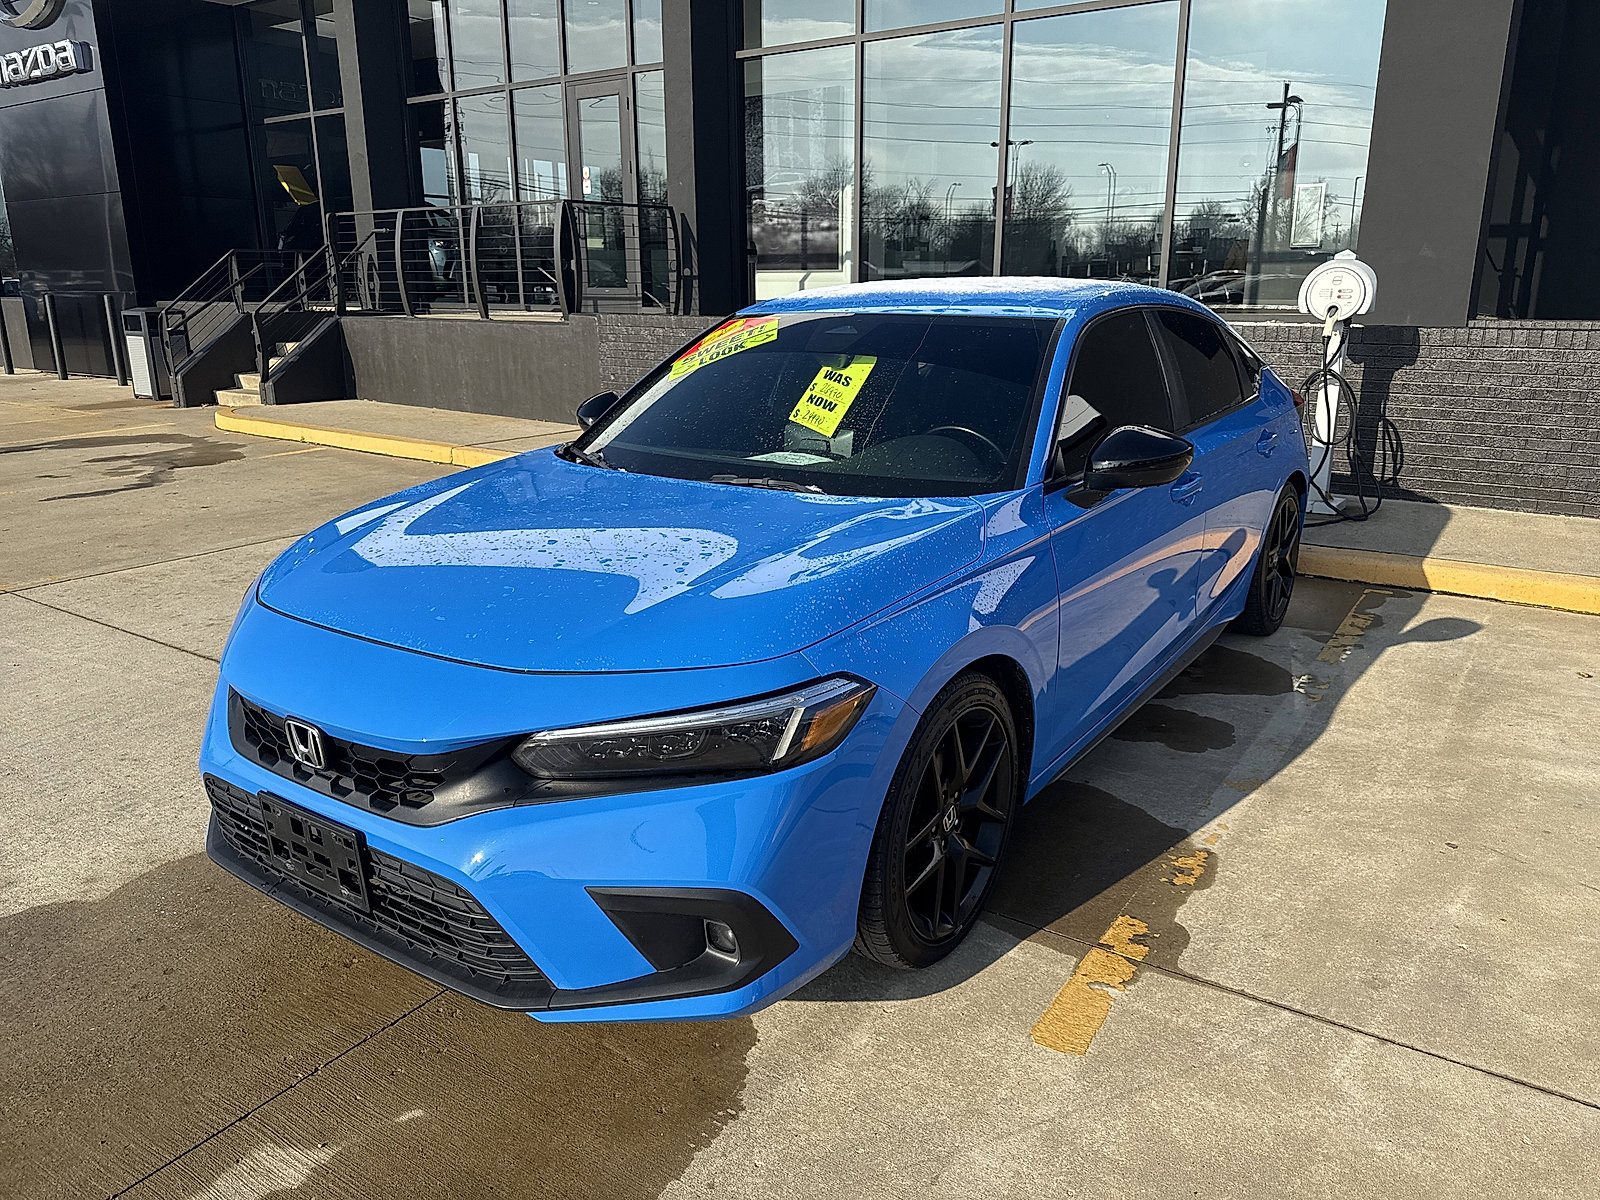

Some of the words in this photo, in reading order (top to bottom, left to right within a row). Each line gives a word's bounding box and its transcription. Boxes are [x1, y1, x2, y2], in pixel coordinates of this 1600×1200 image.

[681, 325, 767, 366] SWEET!
[698, 341, 747, 366] LOOK
[809, 382, 818, 392] $
[823, 369, 852, 387] WAS
[806, 394, 838, 412] NOW
[793, 409, 801, 419] $
